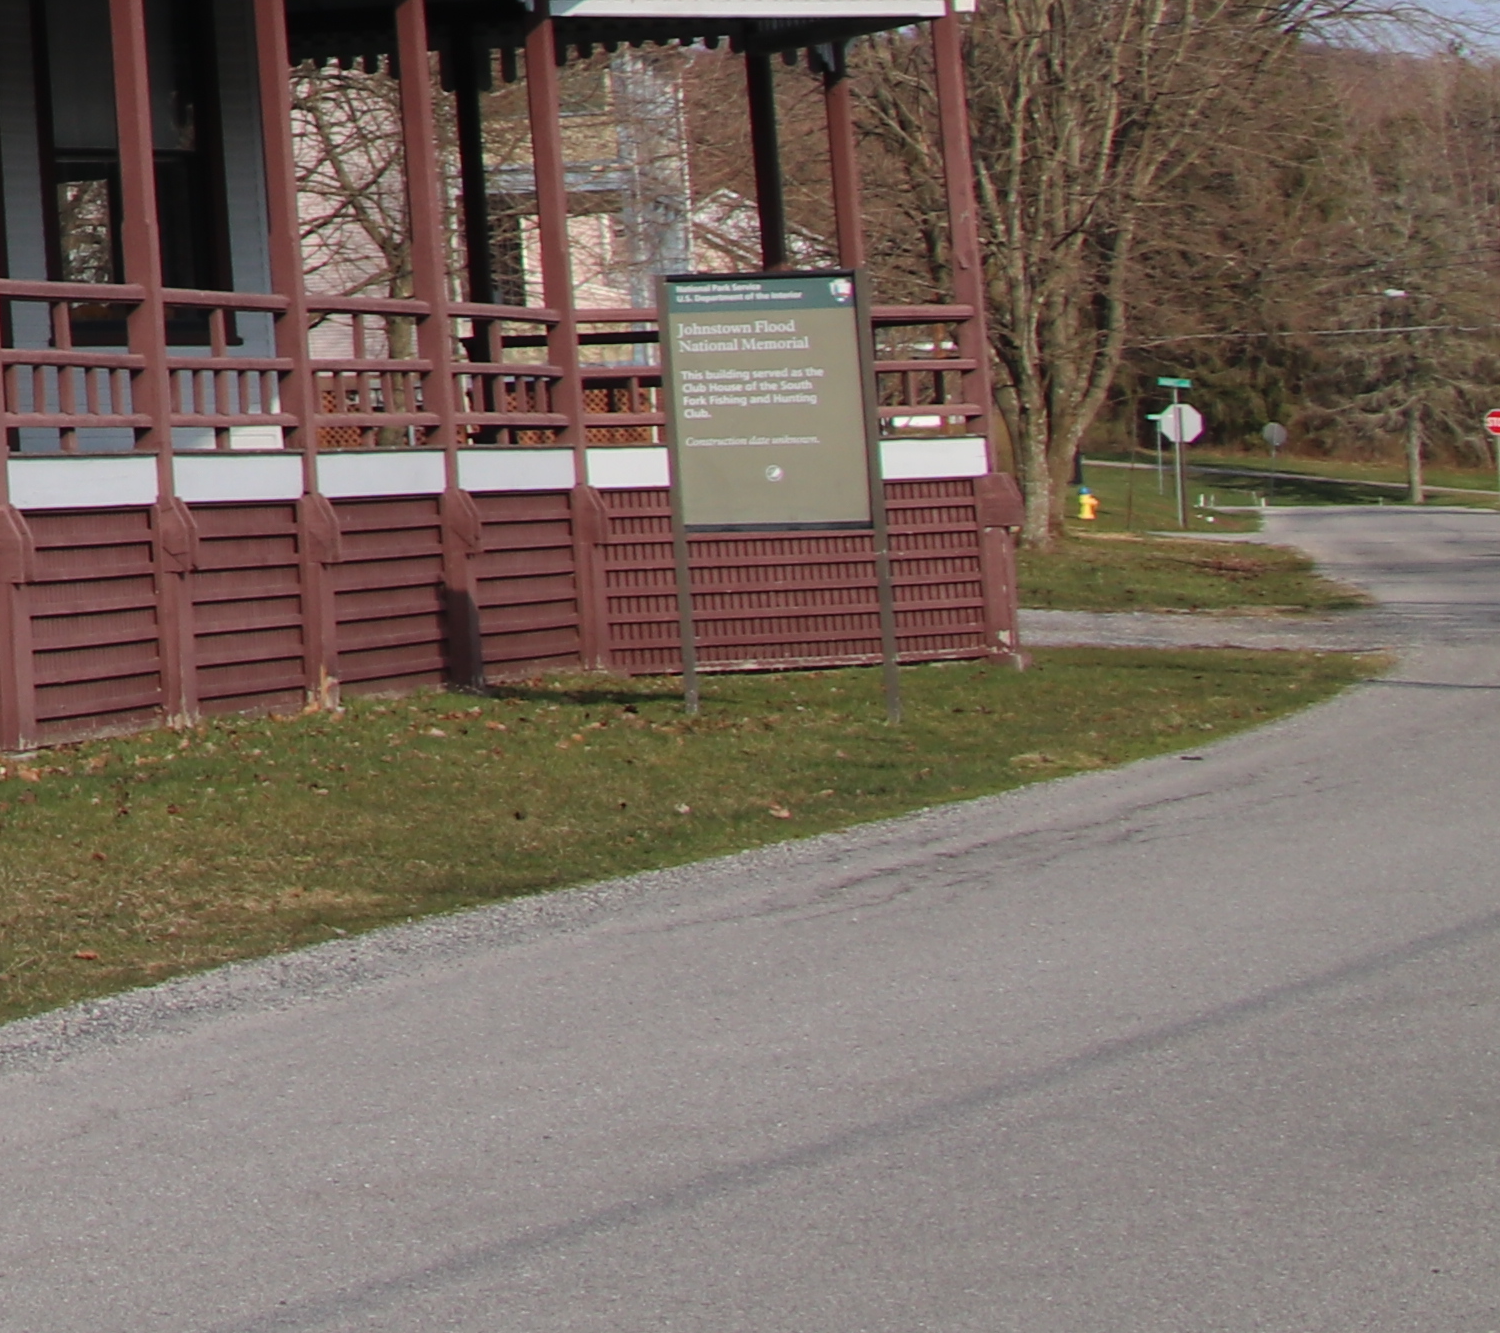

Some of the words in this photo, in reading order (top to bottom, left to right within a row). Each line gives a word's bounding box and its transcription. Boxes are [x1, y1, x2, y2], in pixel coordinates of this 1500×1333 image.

[675, 284, 710, 293] National
[711, 283, 731, 292] Park
[731, 282, 762, 291] Service
[676, 294, 692, 303] U.S.
[693, 293, 744, 303] Department
[744, 292, 755, 301] of
[755, 291, 770, 300] the
[770, 290, 803, 299] Interior
[677, 322, 752, 338] Johnstown
[754, 319, 795, 333] Flood
[678, 338, 739, 352] National
[741, 336, 810, 350] Memorial
[681, 370, 703, 380] This
[705, 369, 750, 380] building
[752, 368, 788, 378] served
[790, 368, 803, 377] as
[805, 367, 824, 376] the
[682, 383, 707, 393] Club
[709, 382, 743, 392] House
[745, 381, 757, 391] of
[759, 381, 778, 390] the
[780, 380, 813, 390] South
[683, 396, 707, 405] Fork
[709, 394, 747, 406] Fishing
[749, 394, 771, 404] and
[773, 393, 818, 405] Hunting
[684, 408, 712, 419] Club.
[685, 436, 747, 447] Construction
[748, 435, 771, 445] date
[771, 434, 820, 445] unknown.
